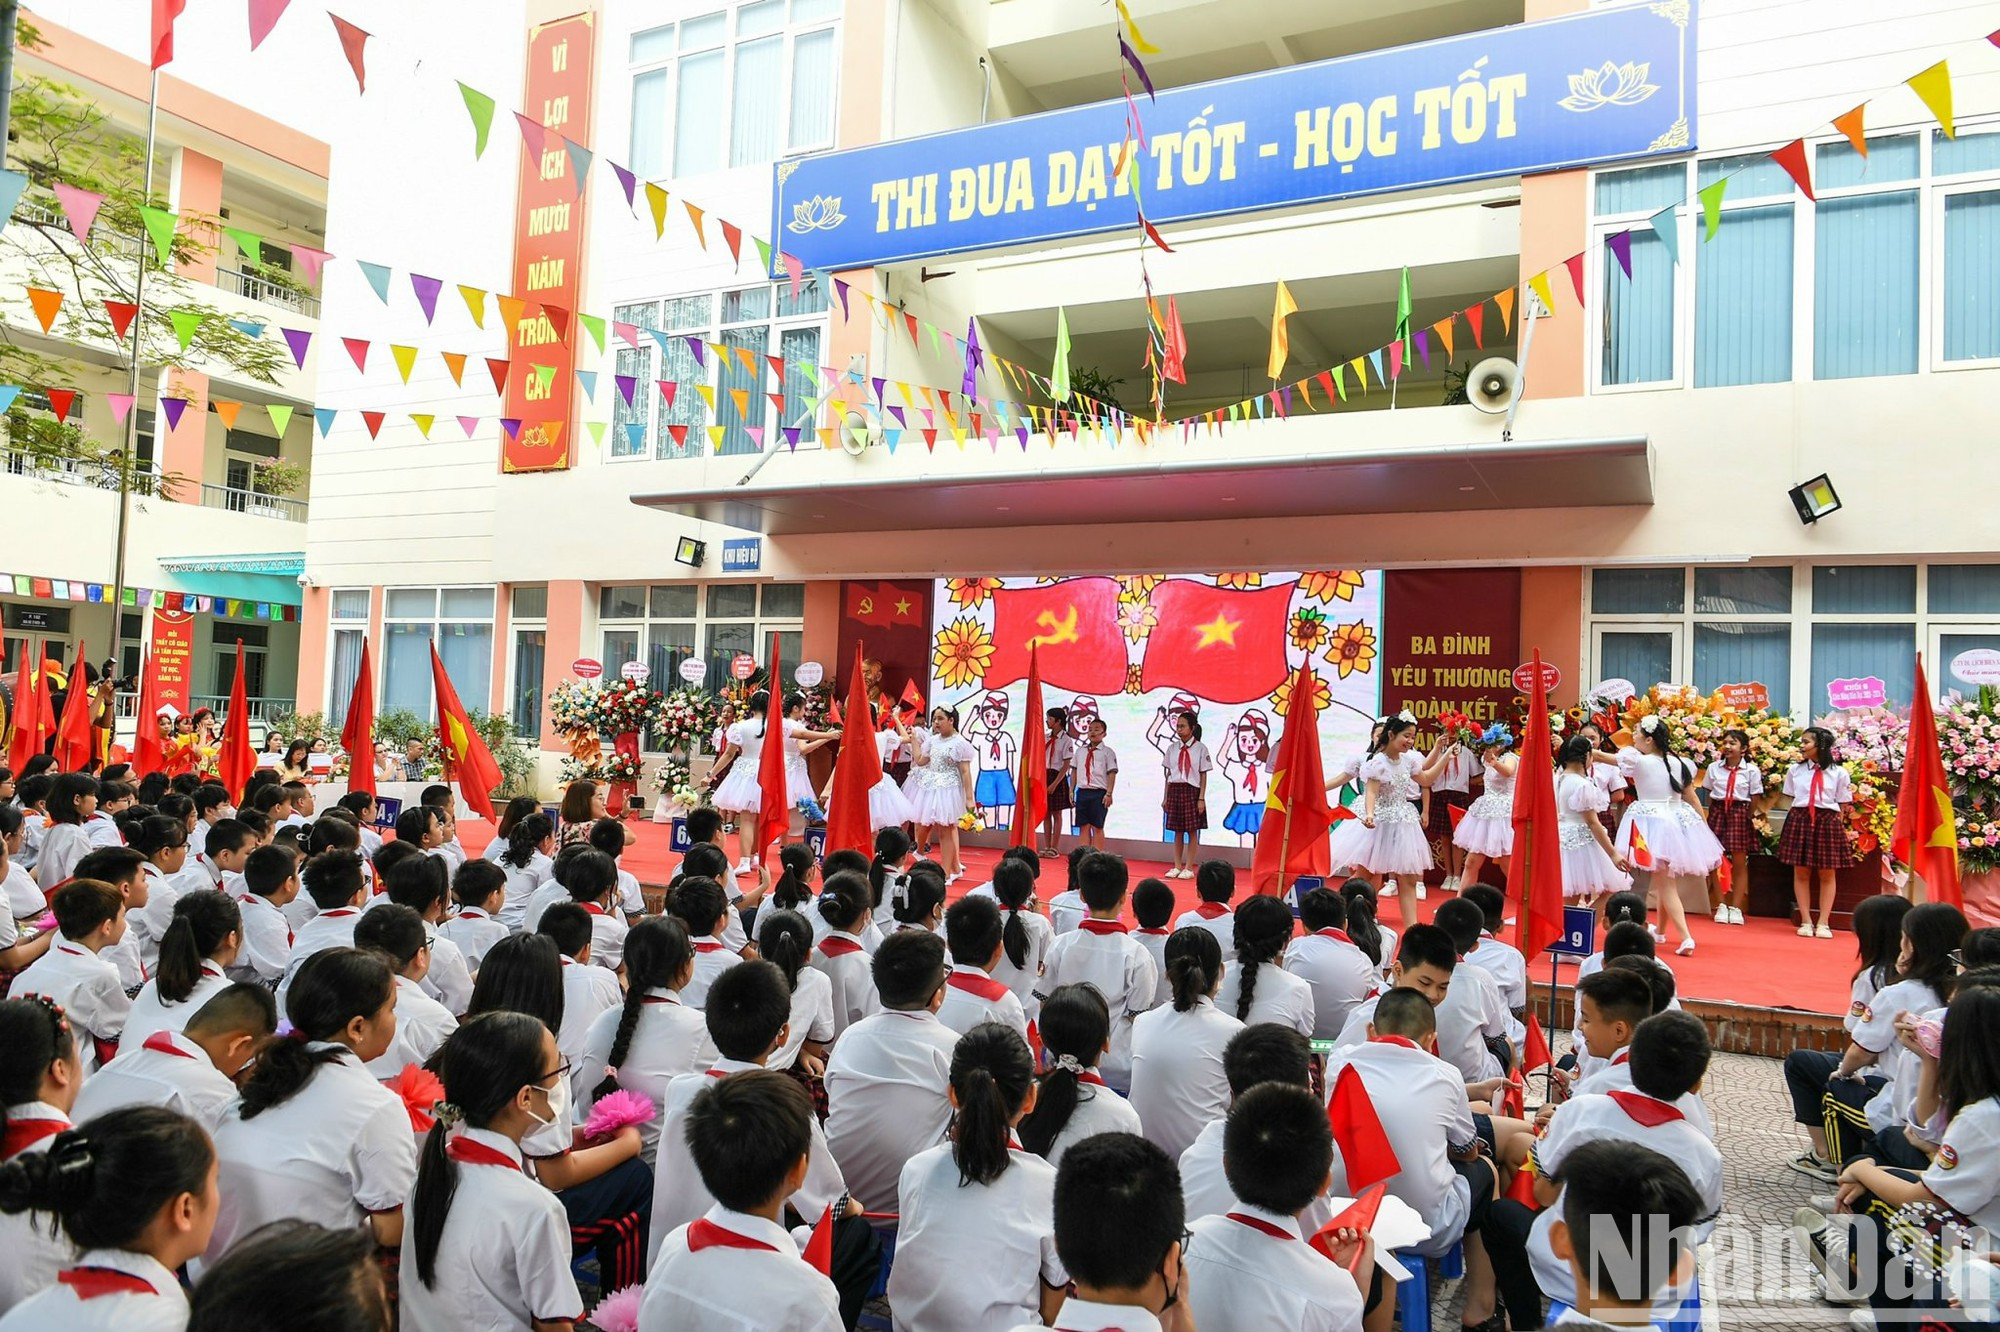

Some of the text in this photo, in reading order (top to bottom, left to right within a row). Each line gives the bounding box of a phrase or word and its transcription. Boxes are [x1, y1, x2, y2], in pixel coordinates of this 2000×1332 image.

[552, 38, 568, 73] VÌ
[543, 95, 569, 130] LỢI
[871, 174, 939, 233] THI
[948, 157, 1034, 222] ĐUA
[1047, 139, 1139, 212] DẠY
[1150, 104, 1246, 191] TỐT
[1293, 94, 1398, 174] HỌC
[1413, 54, 1527, 150] TỐT
[539, 147, 566, 182] ÍCH
[528, 199, 571, 237] MƯỜI
[527, 255, 565, 292] NĂM
[517, 308, 568, 347] TRỒN
[1411, 632, 1491, 655] BA ĐÌNH
[1391, 664, 1512, 688] YÊU THƯƠNG
[1461, 696, 1498, 720] KẾT
